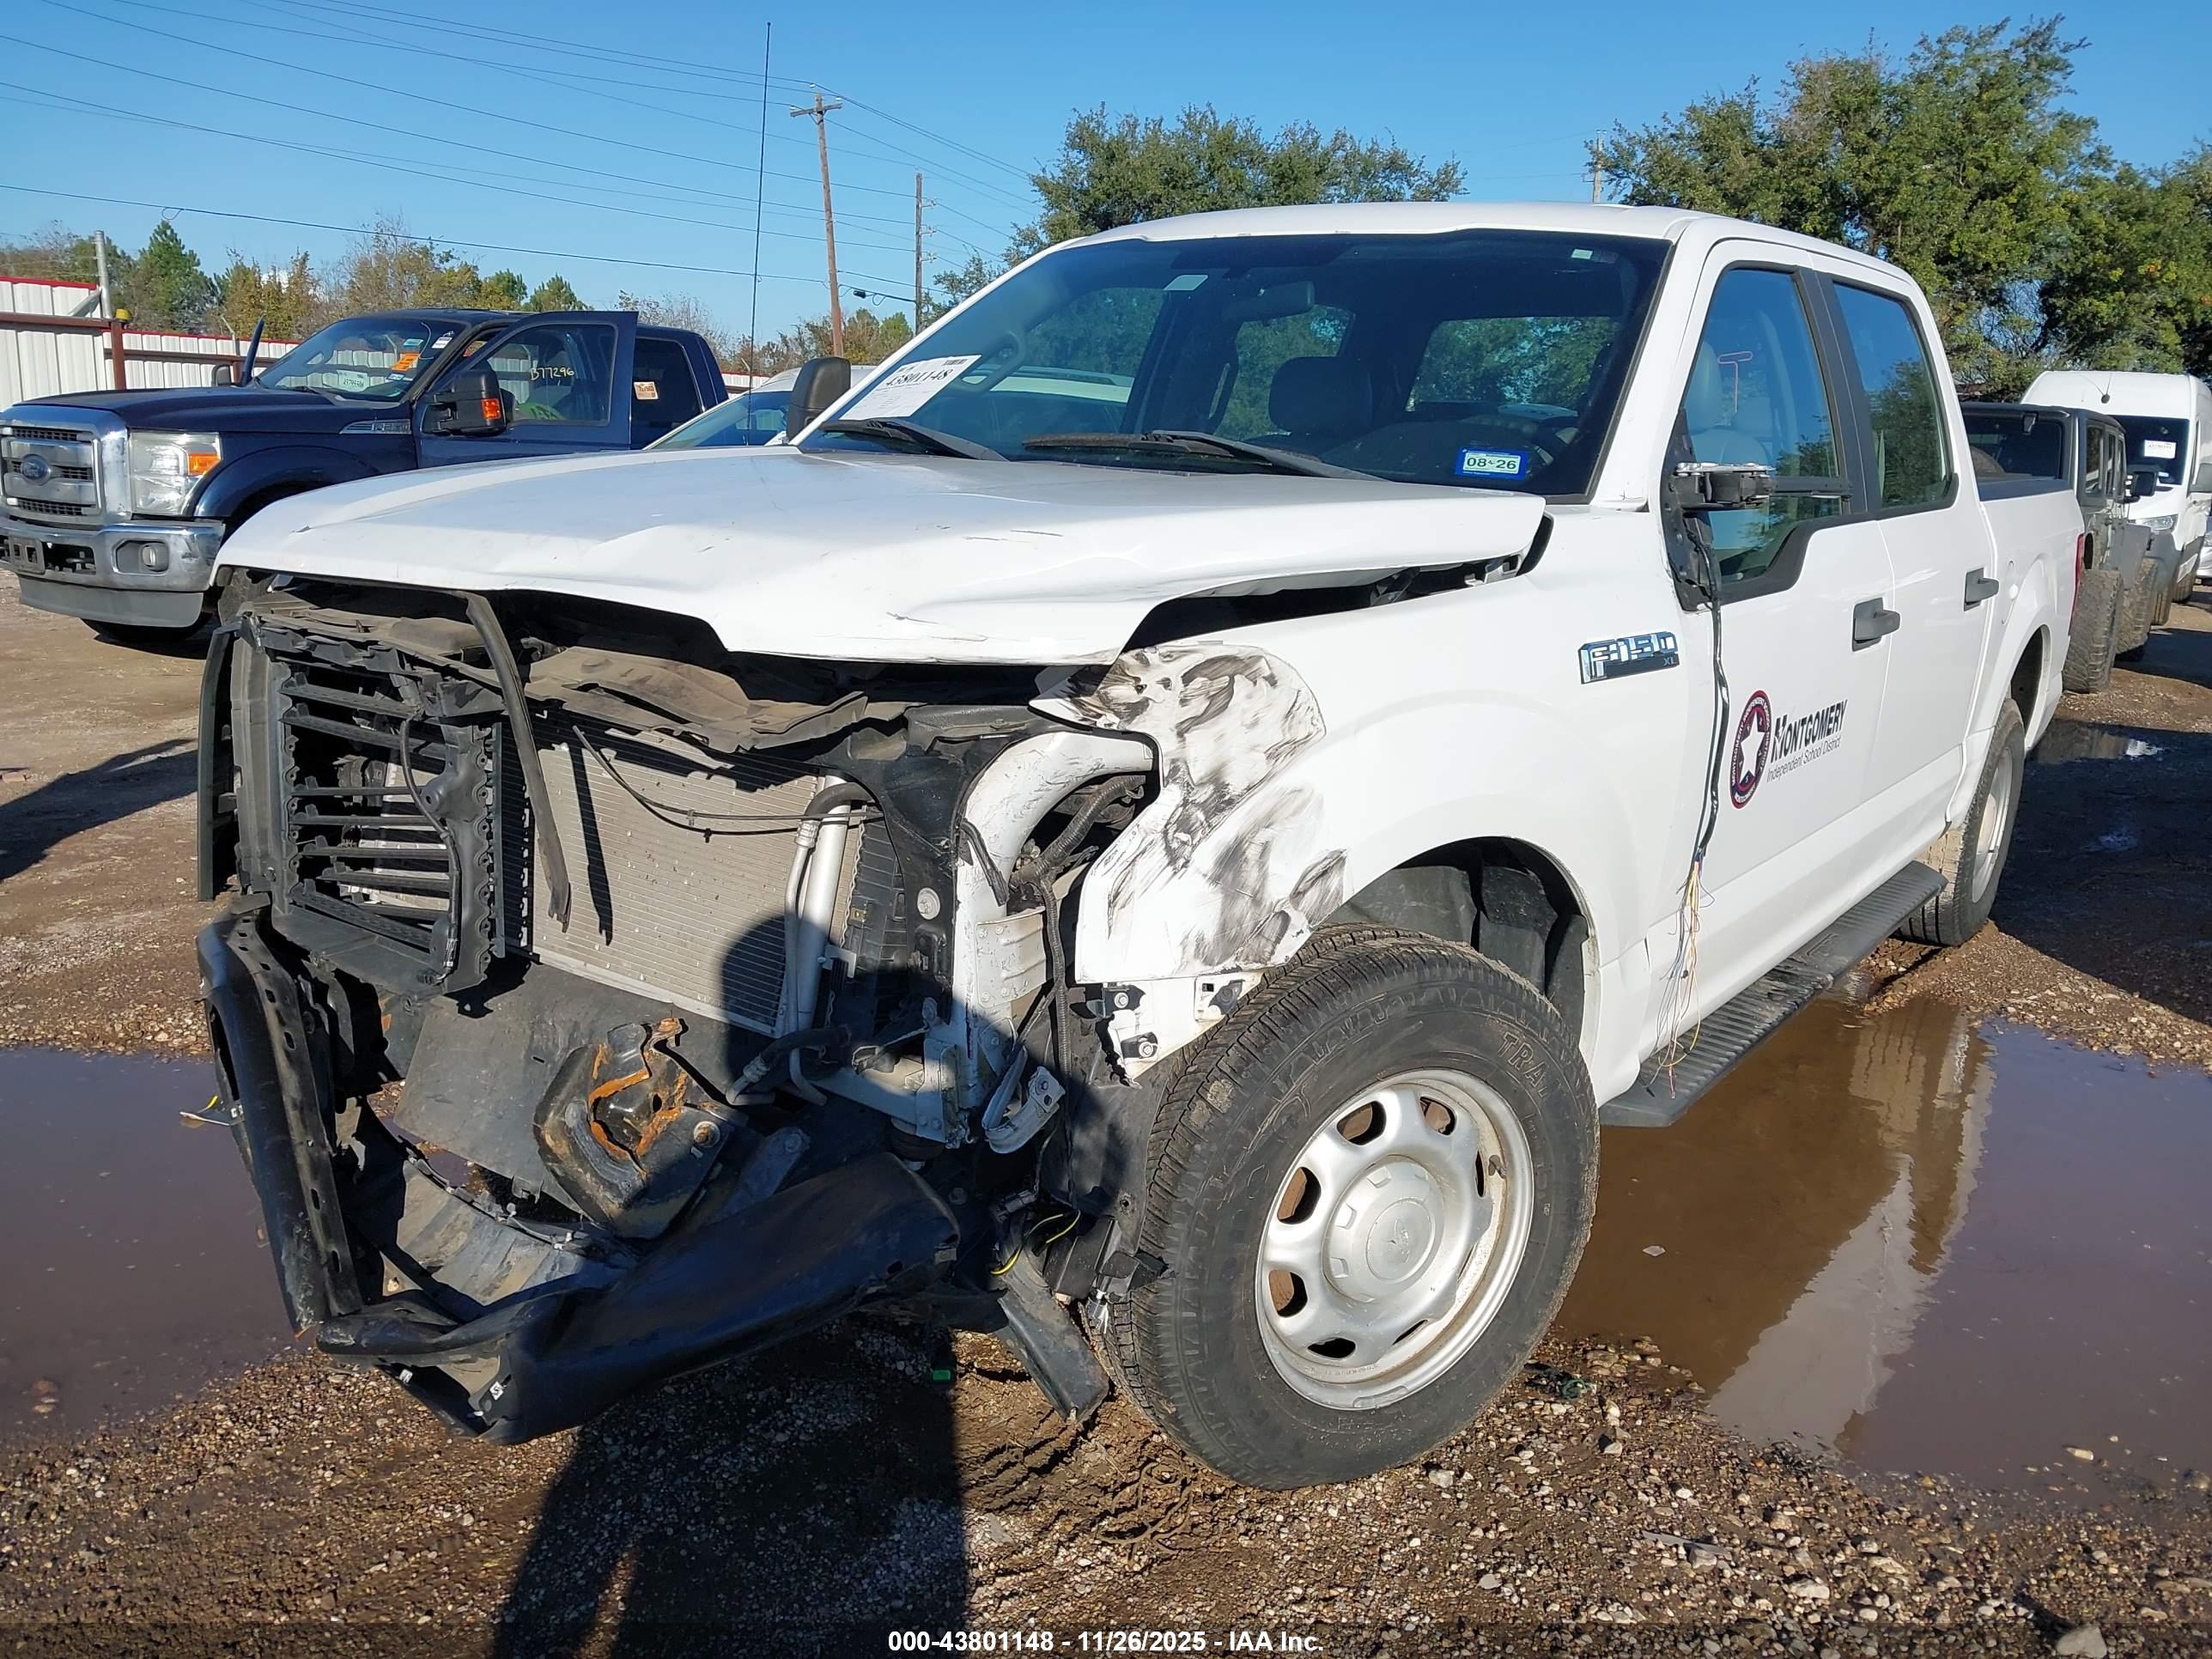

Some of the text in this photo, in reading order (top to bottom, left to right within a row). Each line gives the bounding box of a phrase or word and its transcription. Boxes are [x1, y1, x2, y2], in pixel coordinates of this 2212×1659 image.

[531, 367, 574, 380] B77296
[1663, 656, 1677, 665] XL
[1771, 699, 1848, 763] MONTGOMERY
[1767, 734, 1842, 783] Independent School District
